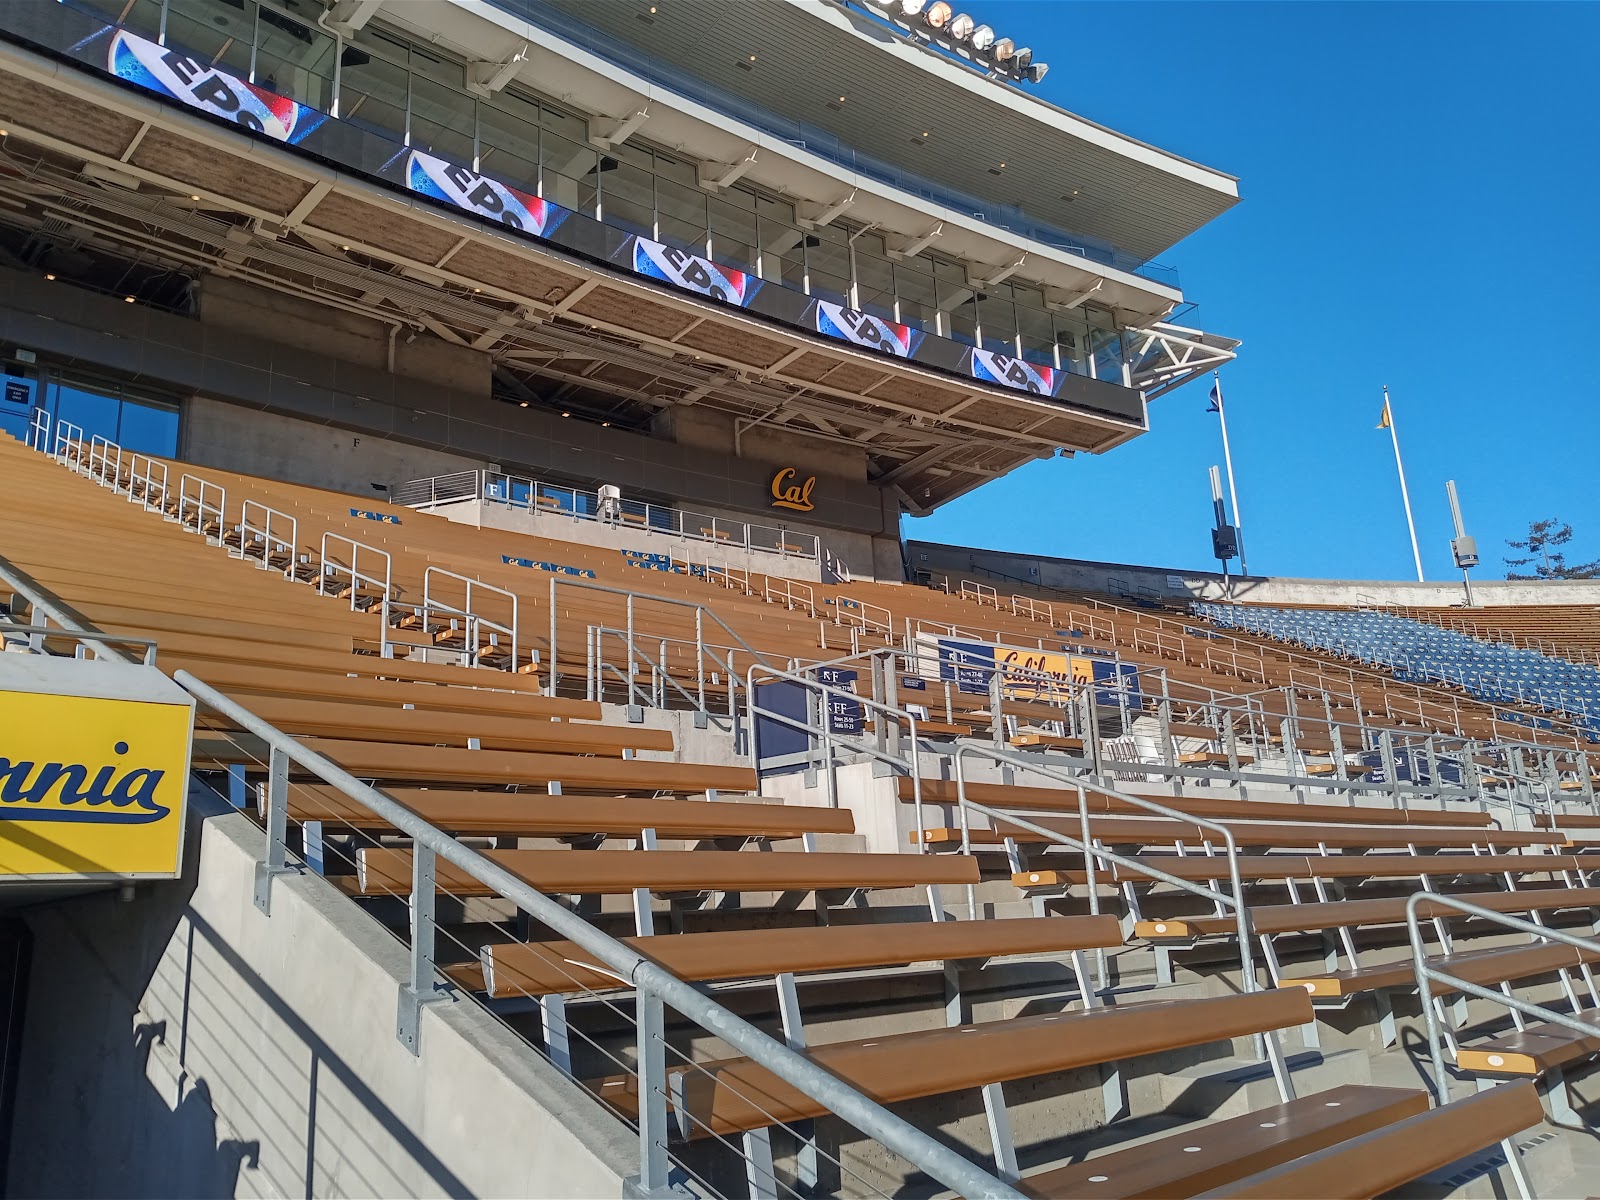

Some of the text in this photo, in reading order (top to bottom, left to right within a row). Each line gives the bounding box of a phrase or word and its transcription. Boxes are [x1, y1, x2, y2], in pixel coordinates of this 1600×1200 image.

[353, 438, 361, 447] F
[489, 484, 497, 496] F
[771, 467, 816, 511] Cal
[832, 671, 838, 682] F
[834, 702, 847, 714] FF
